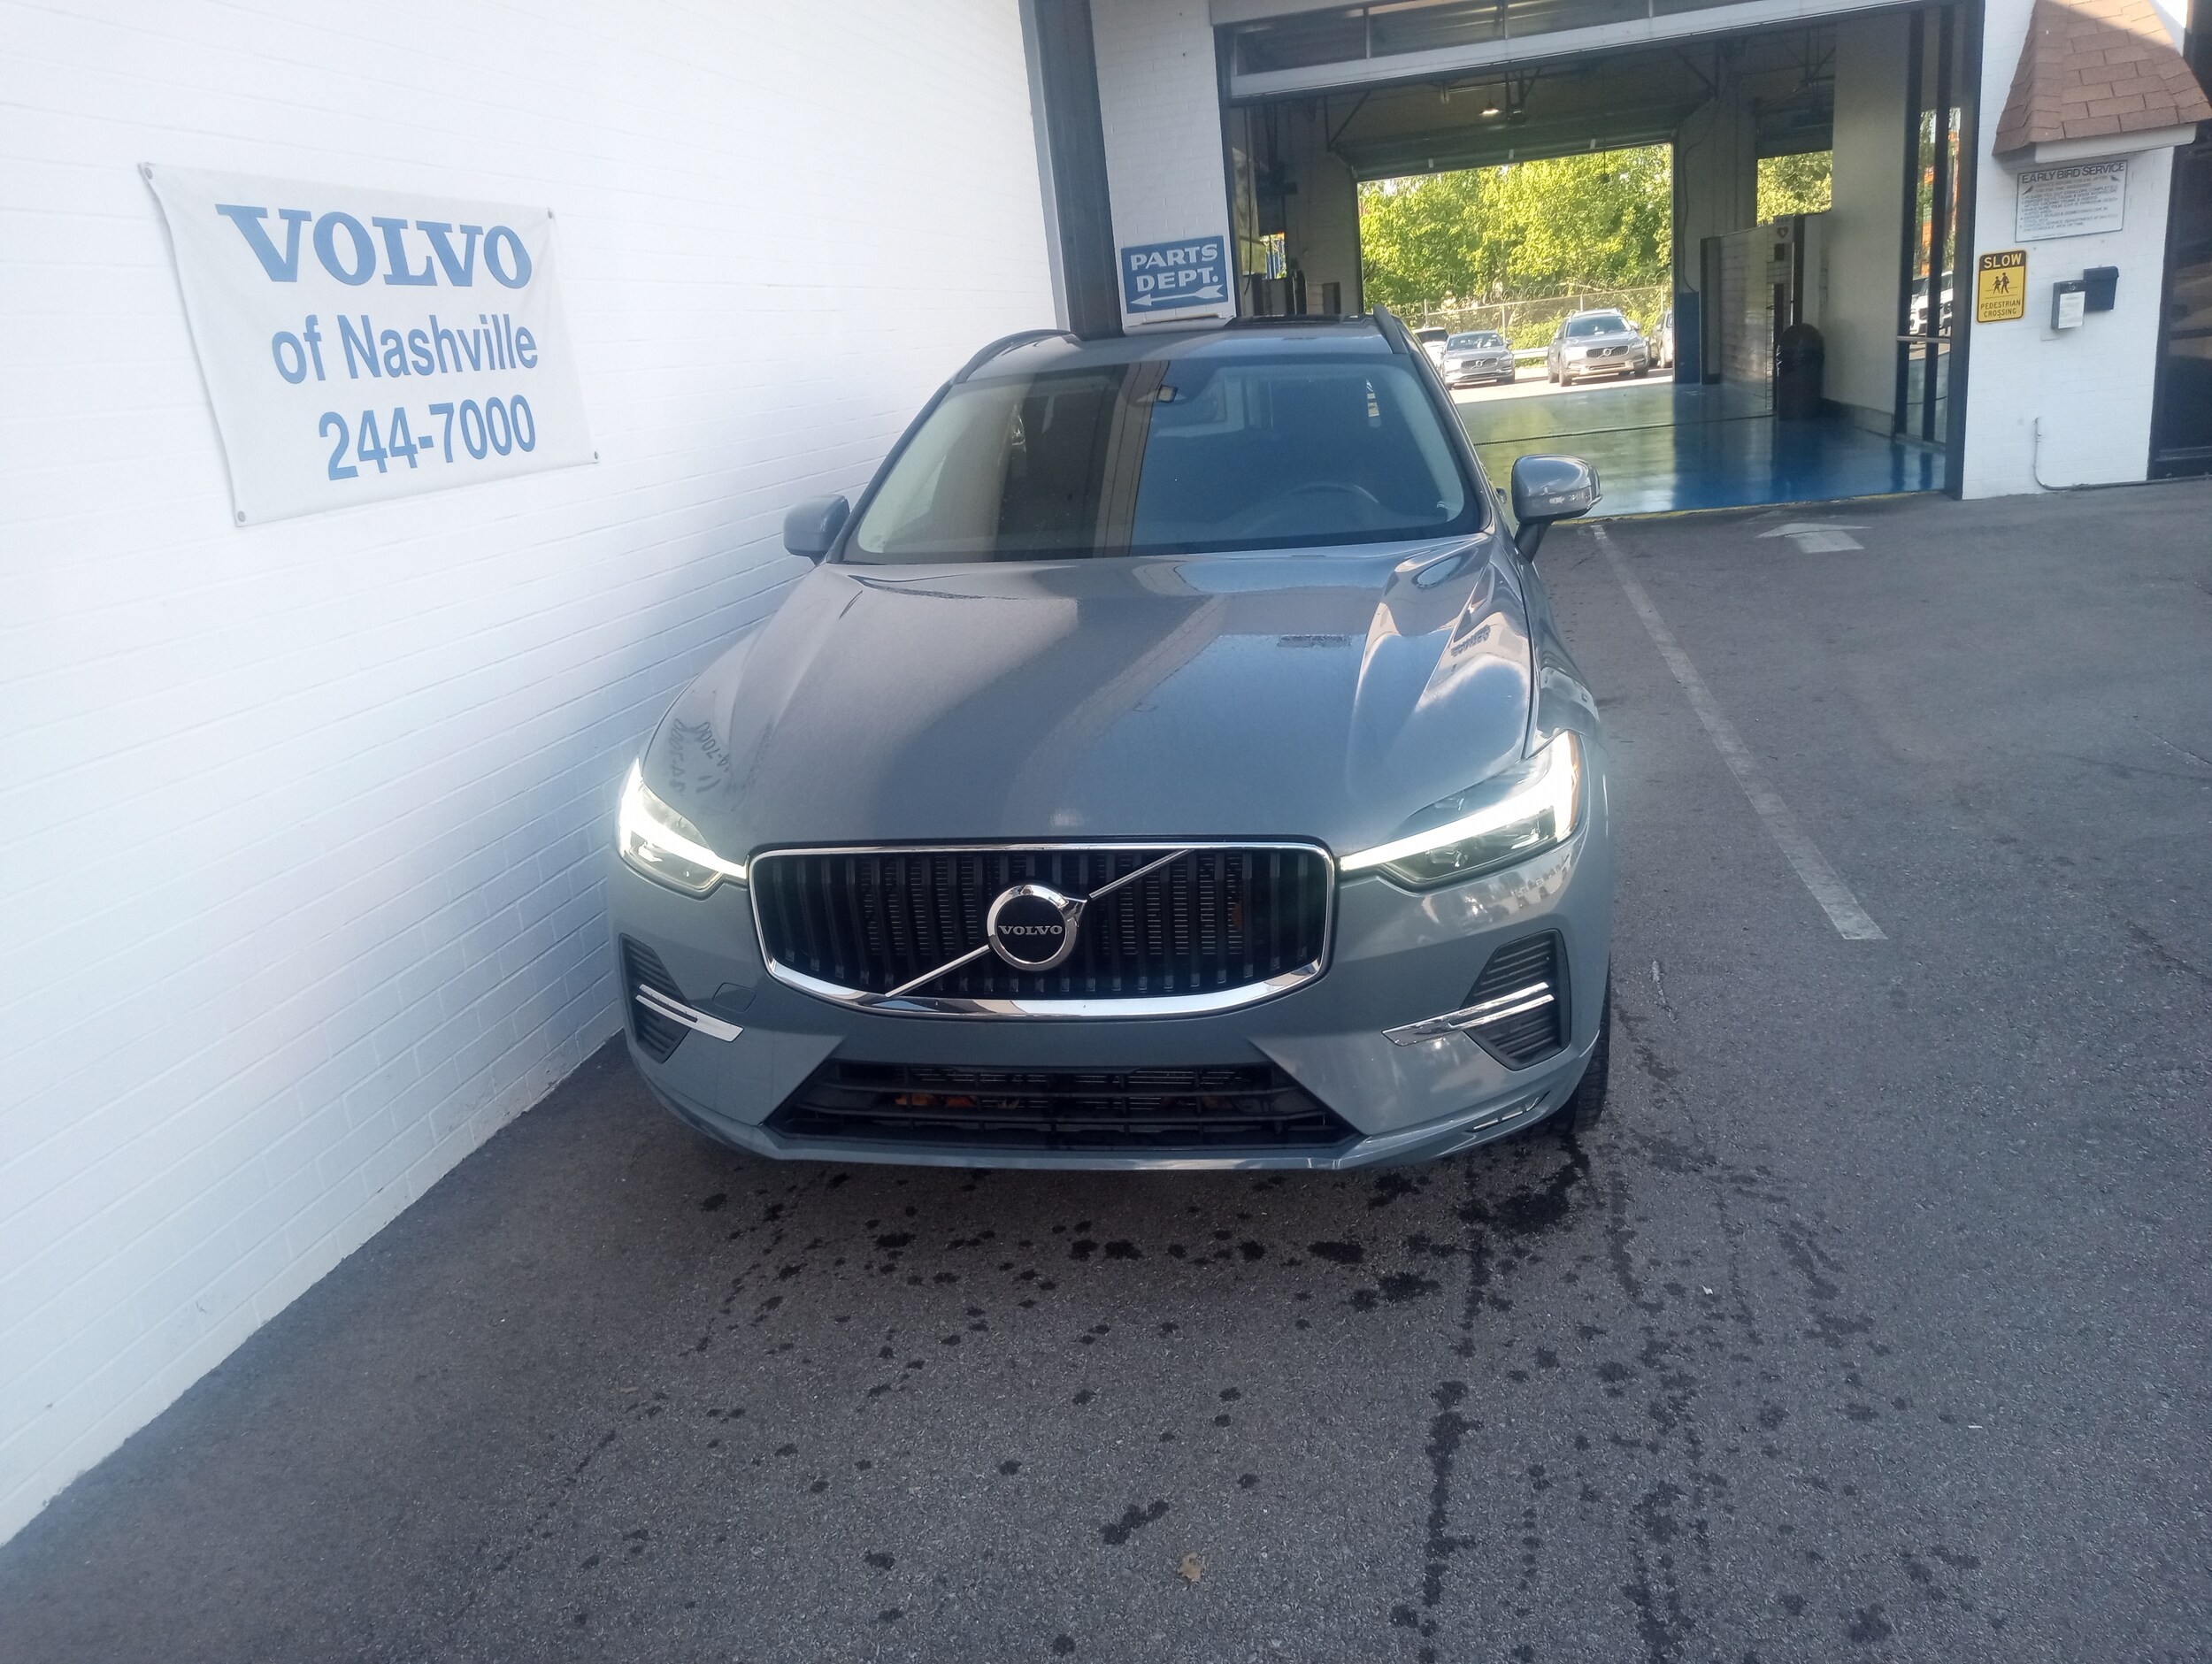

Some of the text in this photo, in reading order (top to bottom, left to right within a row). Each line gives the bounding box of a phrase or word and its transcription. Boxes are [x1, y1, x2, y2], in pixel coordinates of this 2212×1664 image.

[2022, 162, 2124, 184] EARLY BIRD SERVICE
[214, 203, 533, 289] VOLVO
[1130, 243, 1218, 272] PARTS
[1984, 253, 2022, 269] SLOW
[1136, 266, 1219, 293] DEPT.
[1980, 299, 2021, 310] PEDESTRIAN
[1984, 308, 2016, 318] CROSSING
[271, 313, 539, 385] of Nashville
[318, 395, 536, 481] 244-7000
[997, 924, 1063, 936] VOLVO
